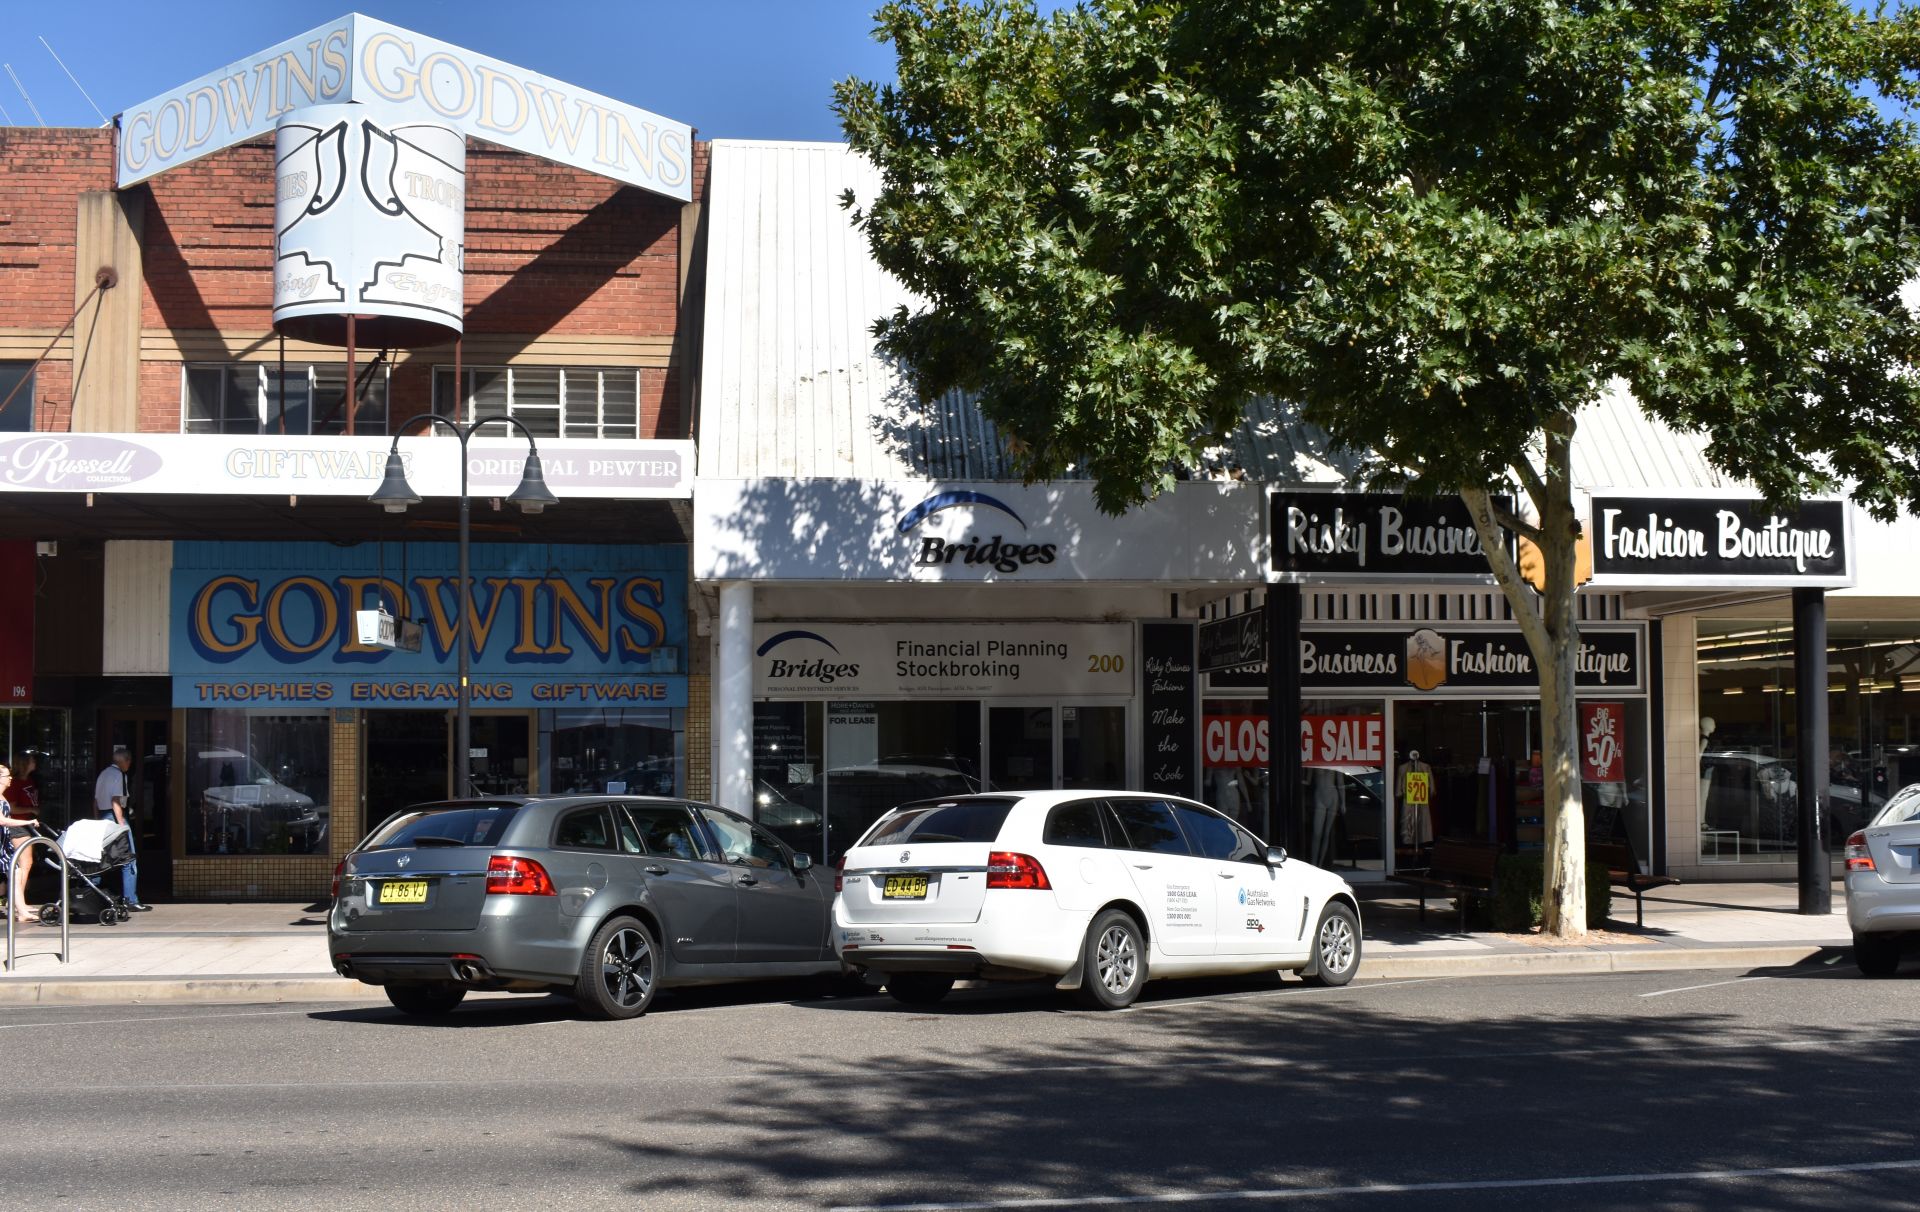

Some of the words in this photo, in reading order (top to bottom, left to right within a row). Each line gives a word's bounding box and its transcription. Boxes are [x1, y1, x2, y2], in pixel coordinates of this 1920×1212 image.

[124, 27, 349, 173] GODWINS
[361, 32, 687, 187] GODWINS
[6, 438, 137, 484] Russell
[468, 459, 578, 476] ORIETAL
[588, 460, 678, 477] PEWTER
[86, 475, 131, 483] COLLECTION
[1287, 505, 1367, 567] Risky
[1603, 508, 1708, 560] Fashion
[1716, 509, 1834, 573] Boutique
[915, 535, 1057, 573] Bridges
[188, 575, 665, 662] GODWINS
[896, 640, 980, 657] Financial
[987, 640, 1068, 660] Planning
[1300, 640, 1398, 674] Business
[1451, 640, 1532, 675] Fashion
[767, 658, 861, 684] Bridges
[896, 660, 1020, 680] Stockbroking
[1088, 654, 1125, 673] 200
[1146, 656, 1165, 678] Risky
[13, 686, 26, 697] 196
[195, 682, 334, 700] TROPHIES
[532, 682, 668, 700] GIFTWARE
[829, 716, 847, 725] FOR
[848, 716, 876, 725] LEASE
[1152, 708, 1185, 725] Make
[1596, 708, 1609, 720] BIG
[1590, 717, 1616, 738] SALE
[1158, 734, 1179, 752] the
[1206, 719, 1314, 762] CLOSG
[1321, 719, 1382, 762] SALE
[1586, 733, 1622, 769] 50%
[1152, 763, 1184, 782] Look
[1412, 774, 1423, 782] ALL
[1597, 767, 1609, 778] OFF
[1407, 781, 1427, 802] $20
[398, 884, 410, 897] 86
[900, 879, 912, 892] 44
[914, 878, 926, 892] BP
[1247, 889, 1269, 898] Australian
[1247, 897, 1256, 906] Gas
[1256, 897, 1276, 907] Networks
